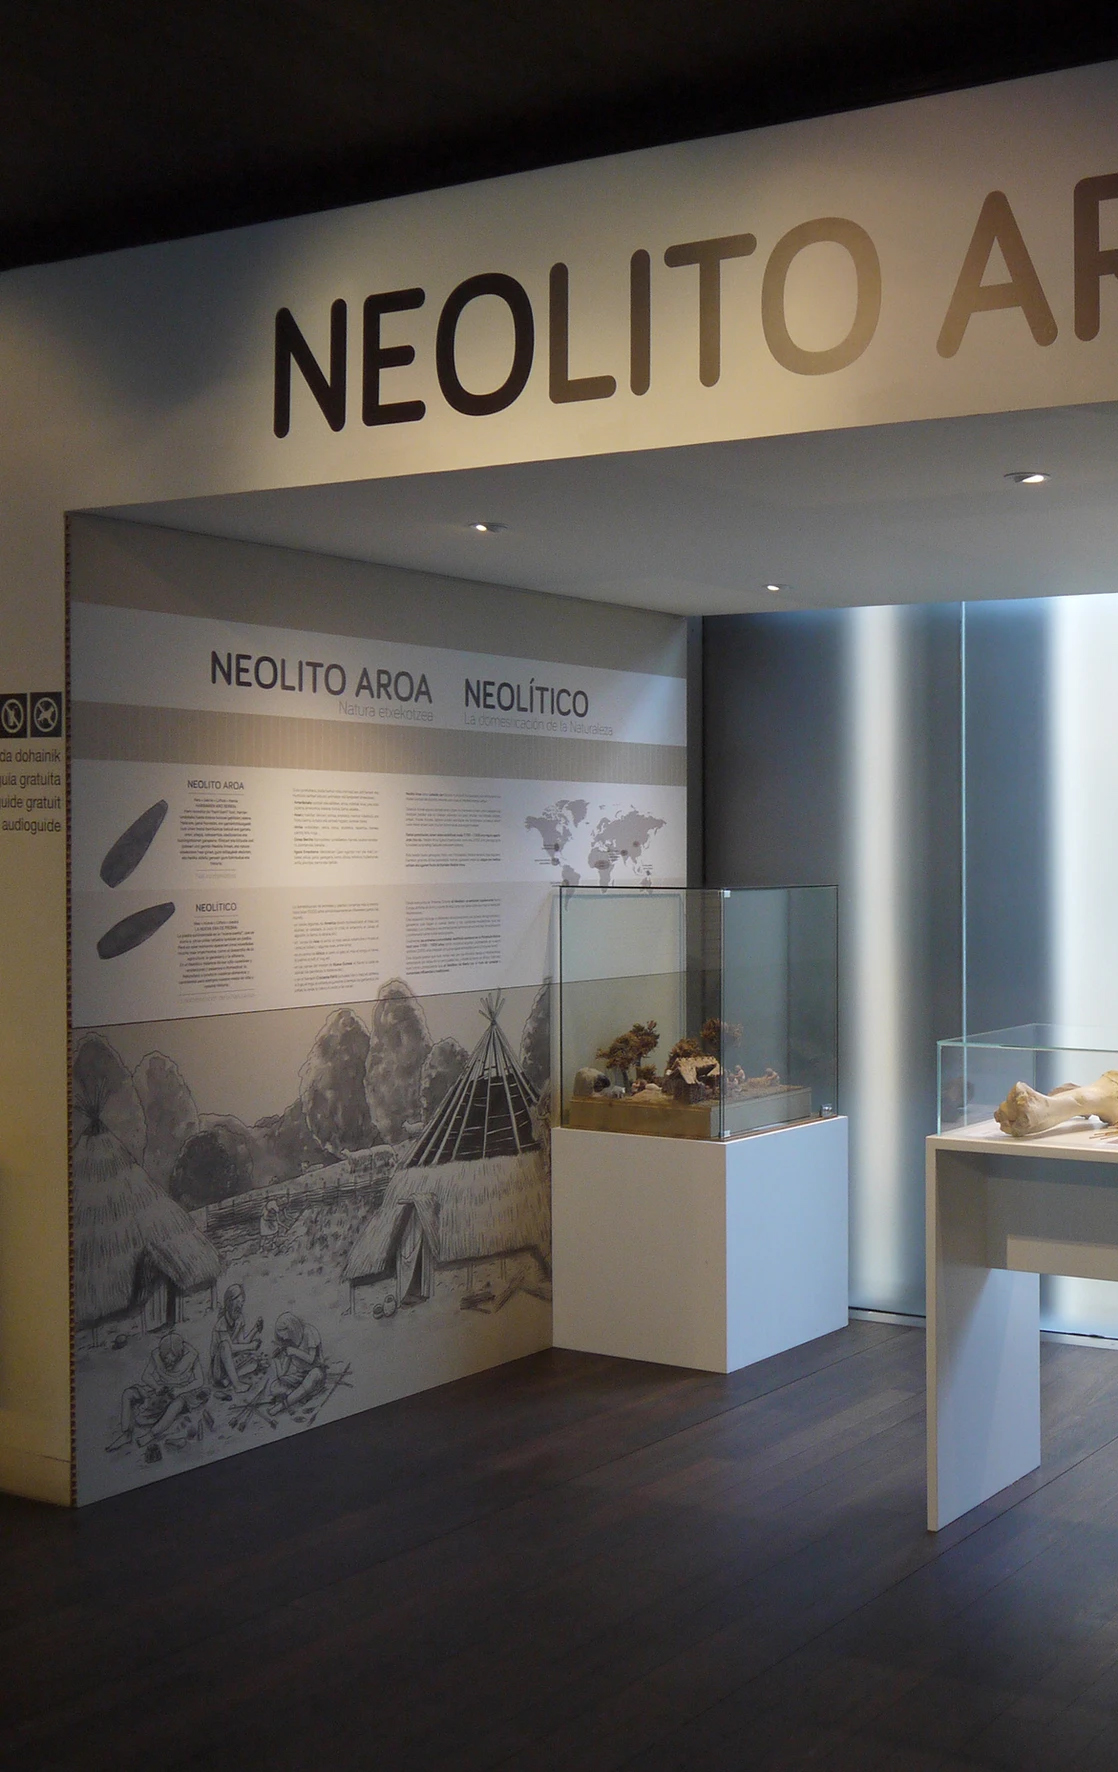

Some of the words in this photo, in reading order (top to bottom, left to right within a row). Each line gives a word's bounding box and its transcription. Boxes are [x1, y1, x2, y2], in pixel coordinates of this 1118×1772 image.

[274, 216, 883, 439] NEOLITO
[211, 650, 347, 696] NEOLITO
[355, 667, 433, 704] AROA
[464, 678, 589, 718] NEOLÍTICO
[338, 701, 376, 718] Natura
[378, 705, 434, 722] etxekotzea
[464, 712, 476, 726] La
[546, 719, 558, 732] de
[559, 721, 568, 733] la
[569, 721, 614, 737] Naturaleza
[15, 749, 61, 762] dohainik
[0, 772, 17, 788] uia
[19, 772, 61, 789] gratuita
[187, 780, 222, 789] NEOLITO
[223, 781, 244, 790] AROA
[0, 795, 23, 809] uide
[25, 795, 61, 812] gratuit
[2, 818, 61, 835] audioguide
[195, 901, 237, 912] NEOLÍTICO
